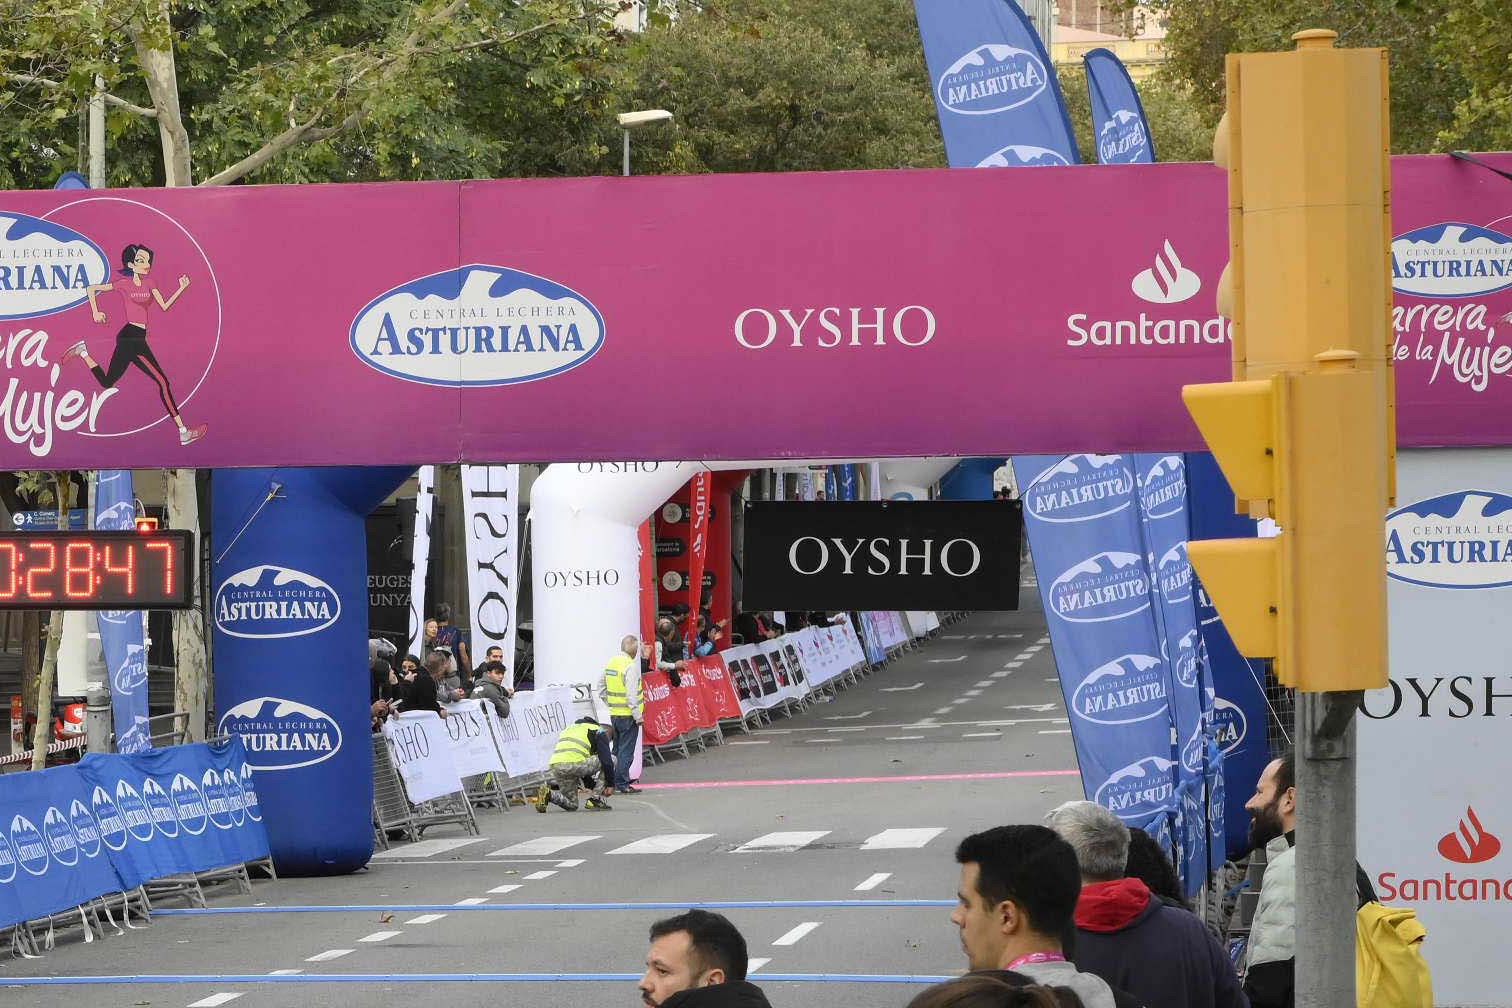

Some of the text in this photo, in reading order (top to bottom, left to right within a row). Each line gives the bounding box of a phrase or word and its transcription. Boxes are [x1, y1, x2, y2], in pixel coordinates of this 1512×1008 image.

[12, 248, 85, 259] LECHERA
[409, 305, 578, 320] CENTRAL LECHERA
[1392, 303, 1488, 332] arrera
[370, 311, 585, 357] ASTURIANA
[734, 305, 936, 349] OYSHO
[1415, 333, 1434, 361] la
[1429, 327, 1512, 392] Muje
[1412, 525, 1478, 536] CENTRAL
[788, 536, 981, 578] OYSHO
[544, 568, 619, 589] OYSHO
[219, 595, 332, 622] ASTURIANA
[231, 590, 327, 599] CENTRAL LECHERA
[1358, 675, 1512, 720] OYSH
[232, 722, 328, 731] CENTRAL LECHERA
[523, 700, 567, 738] OYSHO
